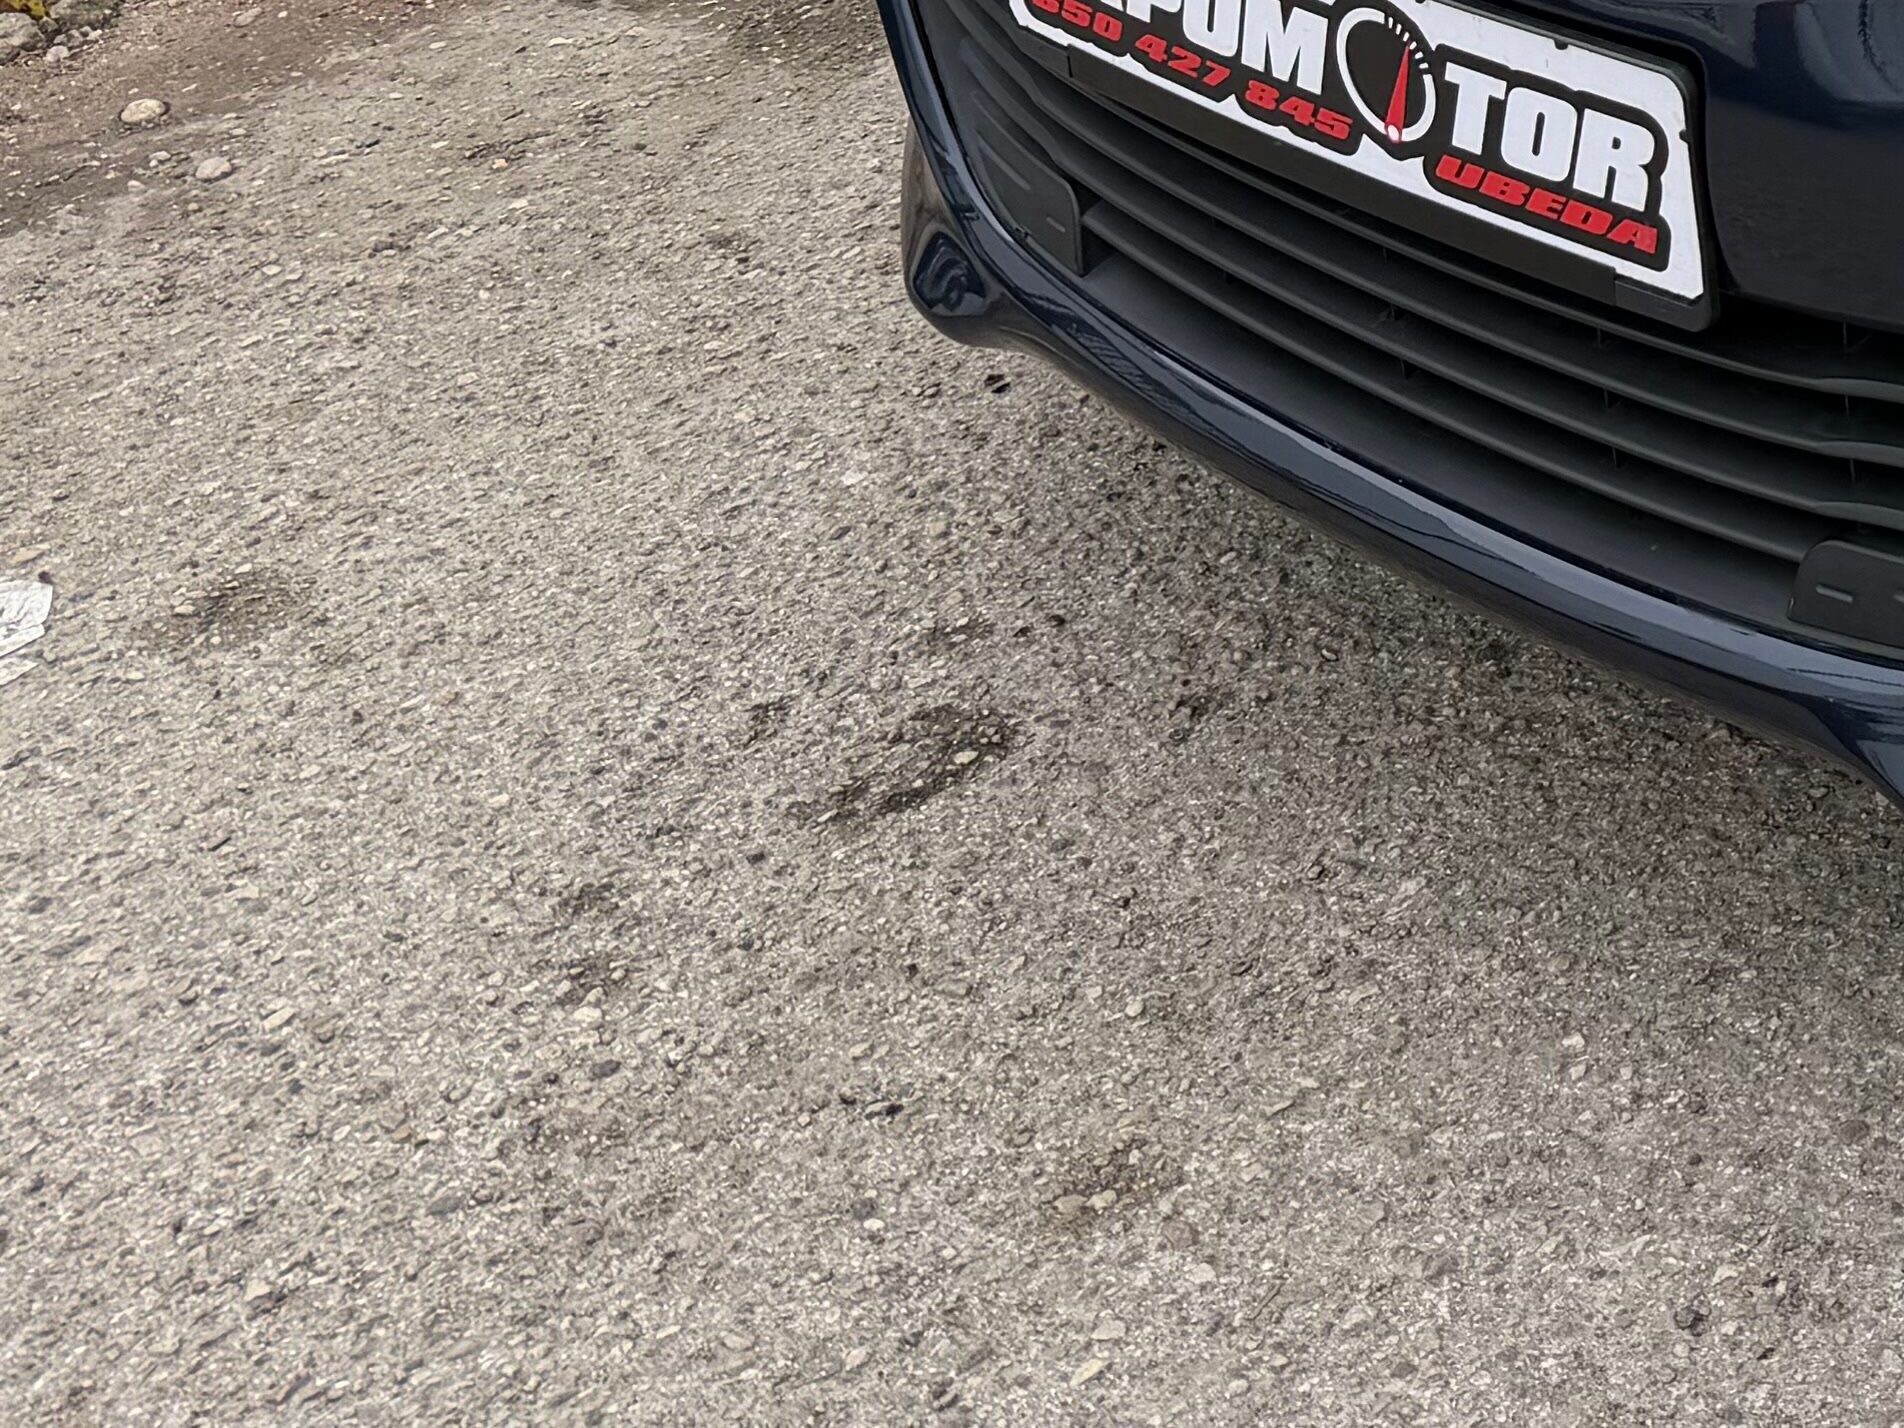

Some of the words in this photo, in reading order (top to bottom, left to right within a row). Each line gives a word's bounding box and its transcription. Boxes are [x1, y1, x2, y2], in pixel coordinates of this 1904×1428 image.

[1135, 32, 1232, 87] 427
[1245, 78, 1354, 141] 845
[1435, 153, 1658, 255] UBEDA
